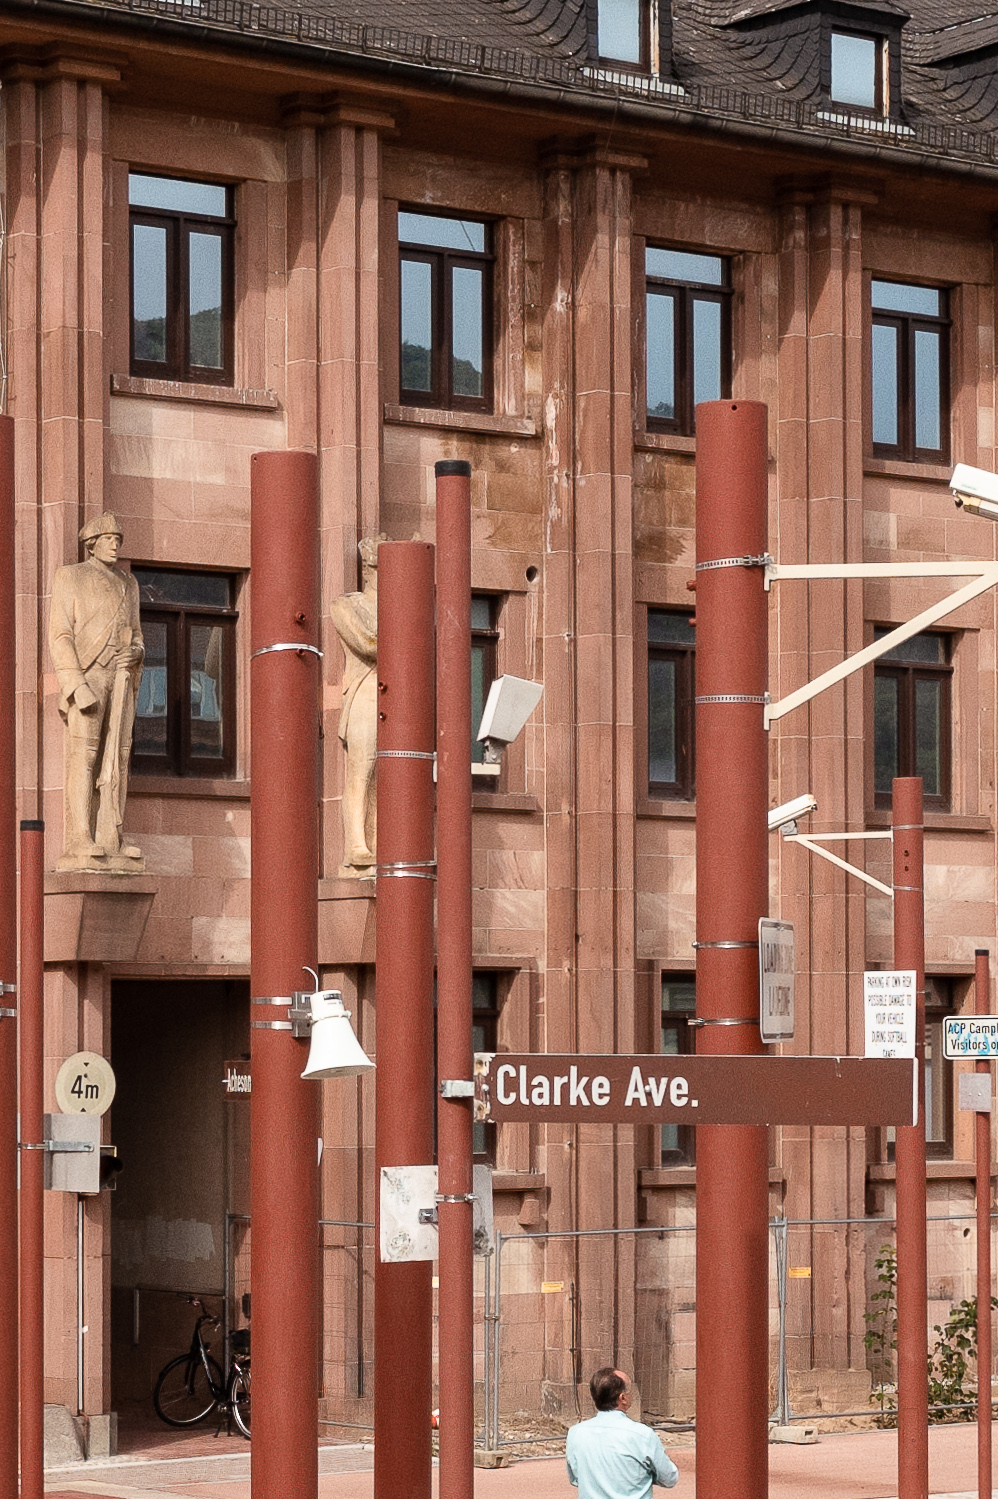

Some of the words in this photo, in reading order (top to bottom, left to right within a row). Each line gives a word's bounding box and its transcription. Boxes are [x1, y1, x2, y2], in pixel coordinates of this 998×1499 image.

[867, 976, 884, 988] PARKING
[886, 976, 891, 988] AT
[892, 976, 900, 988] OWN
[903, 976, 912, 988] RISK
[868, 994, 887, 1007] POSSIBLE
[889, 994, 905, 1007] DAMAGE
[907, 994, 912, 1007] TO
[876, 1012, 886, 1024] YOUR
[888, 1012, 904, 1024] VEHICLE
[948, 1022, 966, 1035] ACP
[872, 1031, 886, 1043] DURING
[887, 1031, 907, 1043] SOFTBALL
[951, 1038, 988, 1051] Visitors
[70, 1074, 99, 1099] 4m
[496, 1063, 612, 1107] Clarke
[624, 1064, 699, 1108] Ave.
